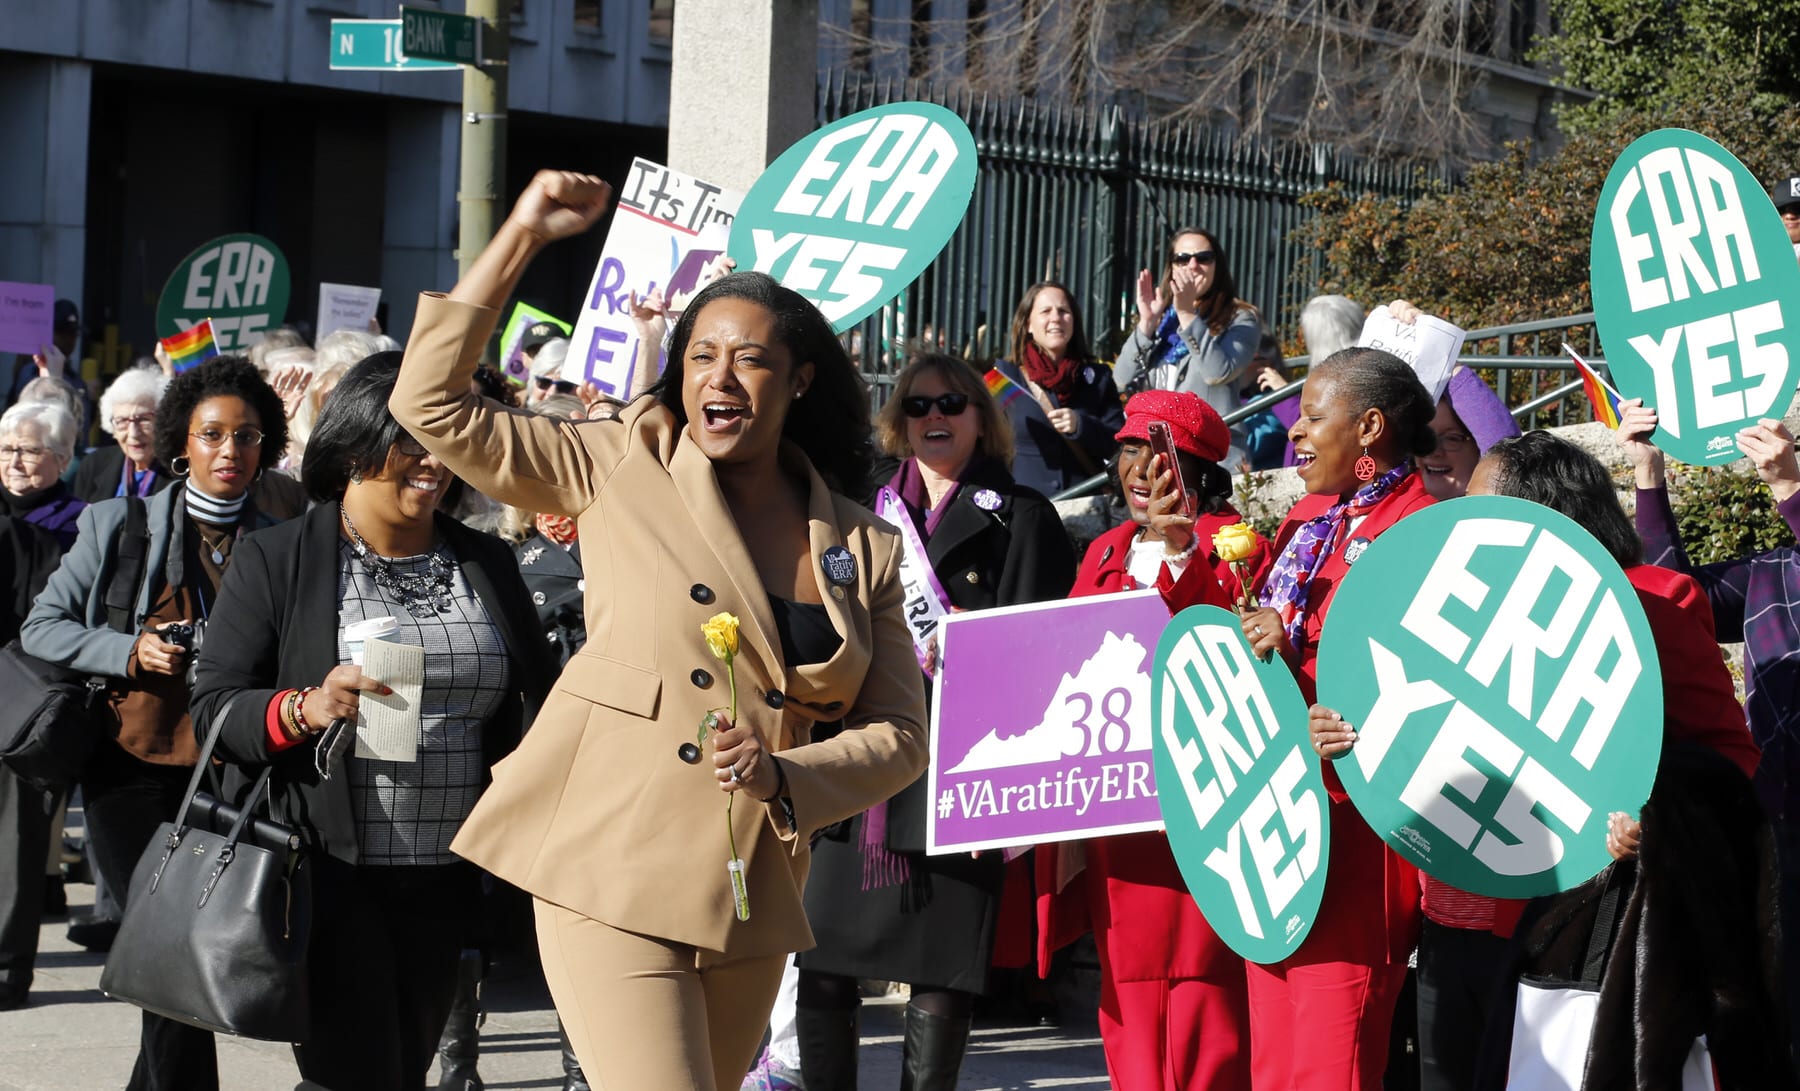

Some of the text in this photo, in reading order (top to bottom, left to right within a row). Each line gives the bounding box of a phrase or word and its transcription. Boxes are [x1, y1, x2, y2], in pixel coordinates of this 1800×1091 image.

[340, 33, 354, 55] N
[405, 14, 446, 54] BANK
[620, 161, 684, 223] It's
[774, 114, 958, 230] ERA
[1609, 147, 1761, 313] ERA
[183, 241, 275, 309] ERA
[752, 229, 908, 326] YES
[1627, 299, 1789, 439] YES
[829, 559, 853, 571] ratify
[832, 569, 853, 580] ERA
[1400, 518, 1643, 772] ERA
[1060, 686, 1132, 758] 38
[1161, 624, 1280, 830] ERA
[1353, 636, 1593, 876] YES
[937, 761, 1159, 819] #VAratifyER
[1203, 744, 1322, 940] YES
